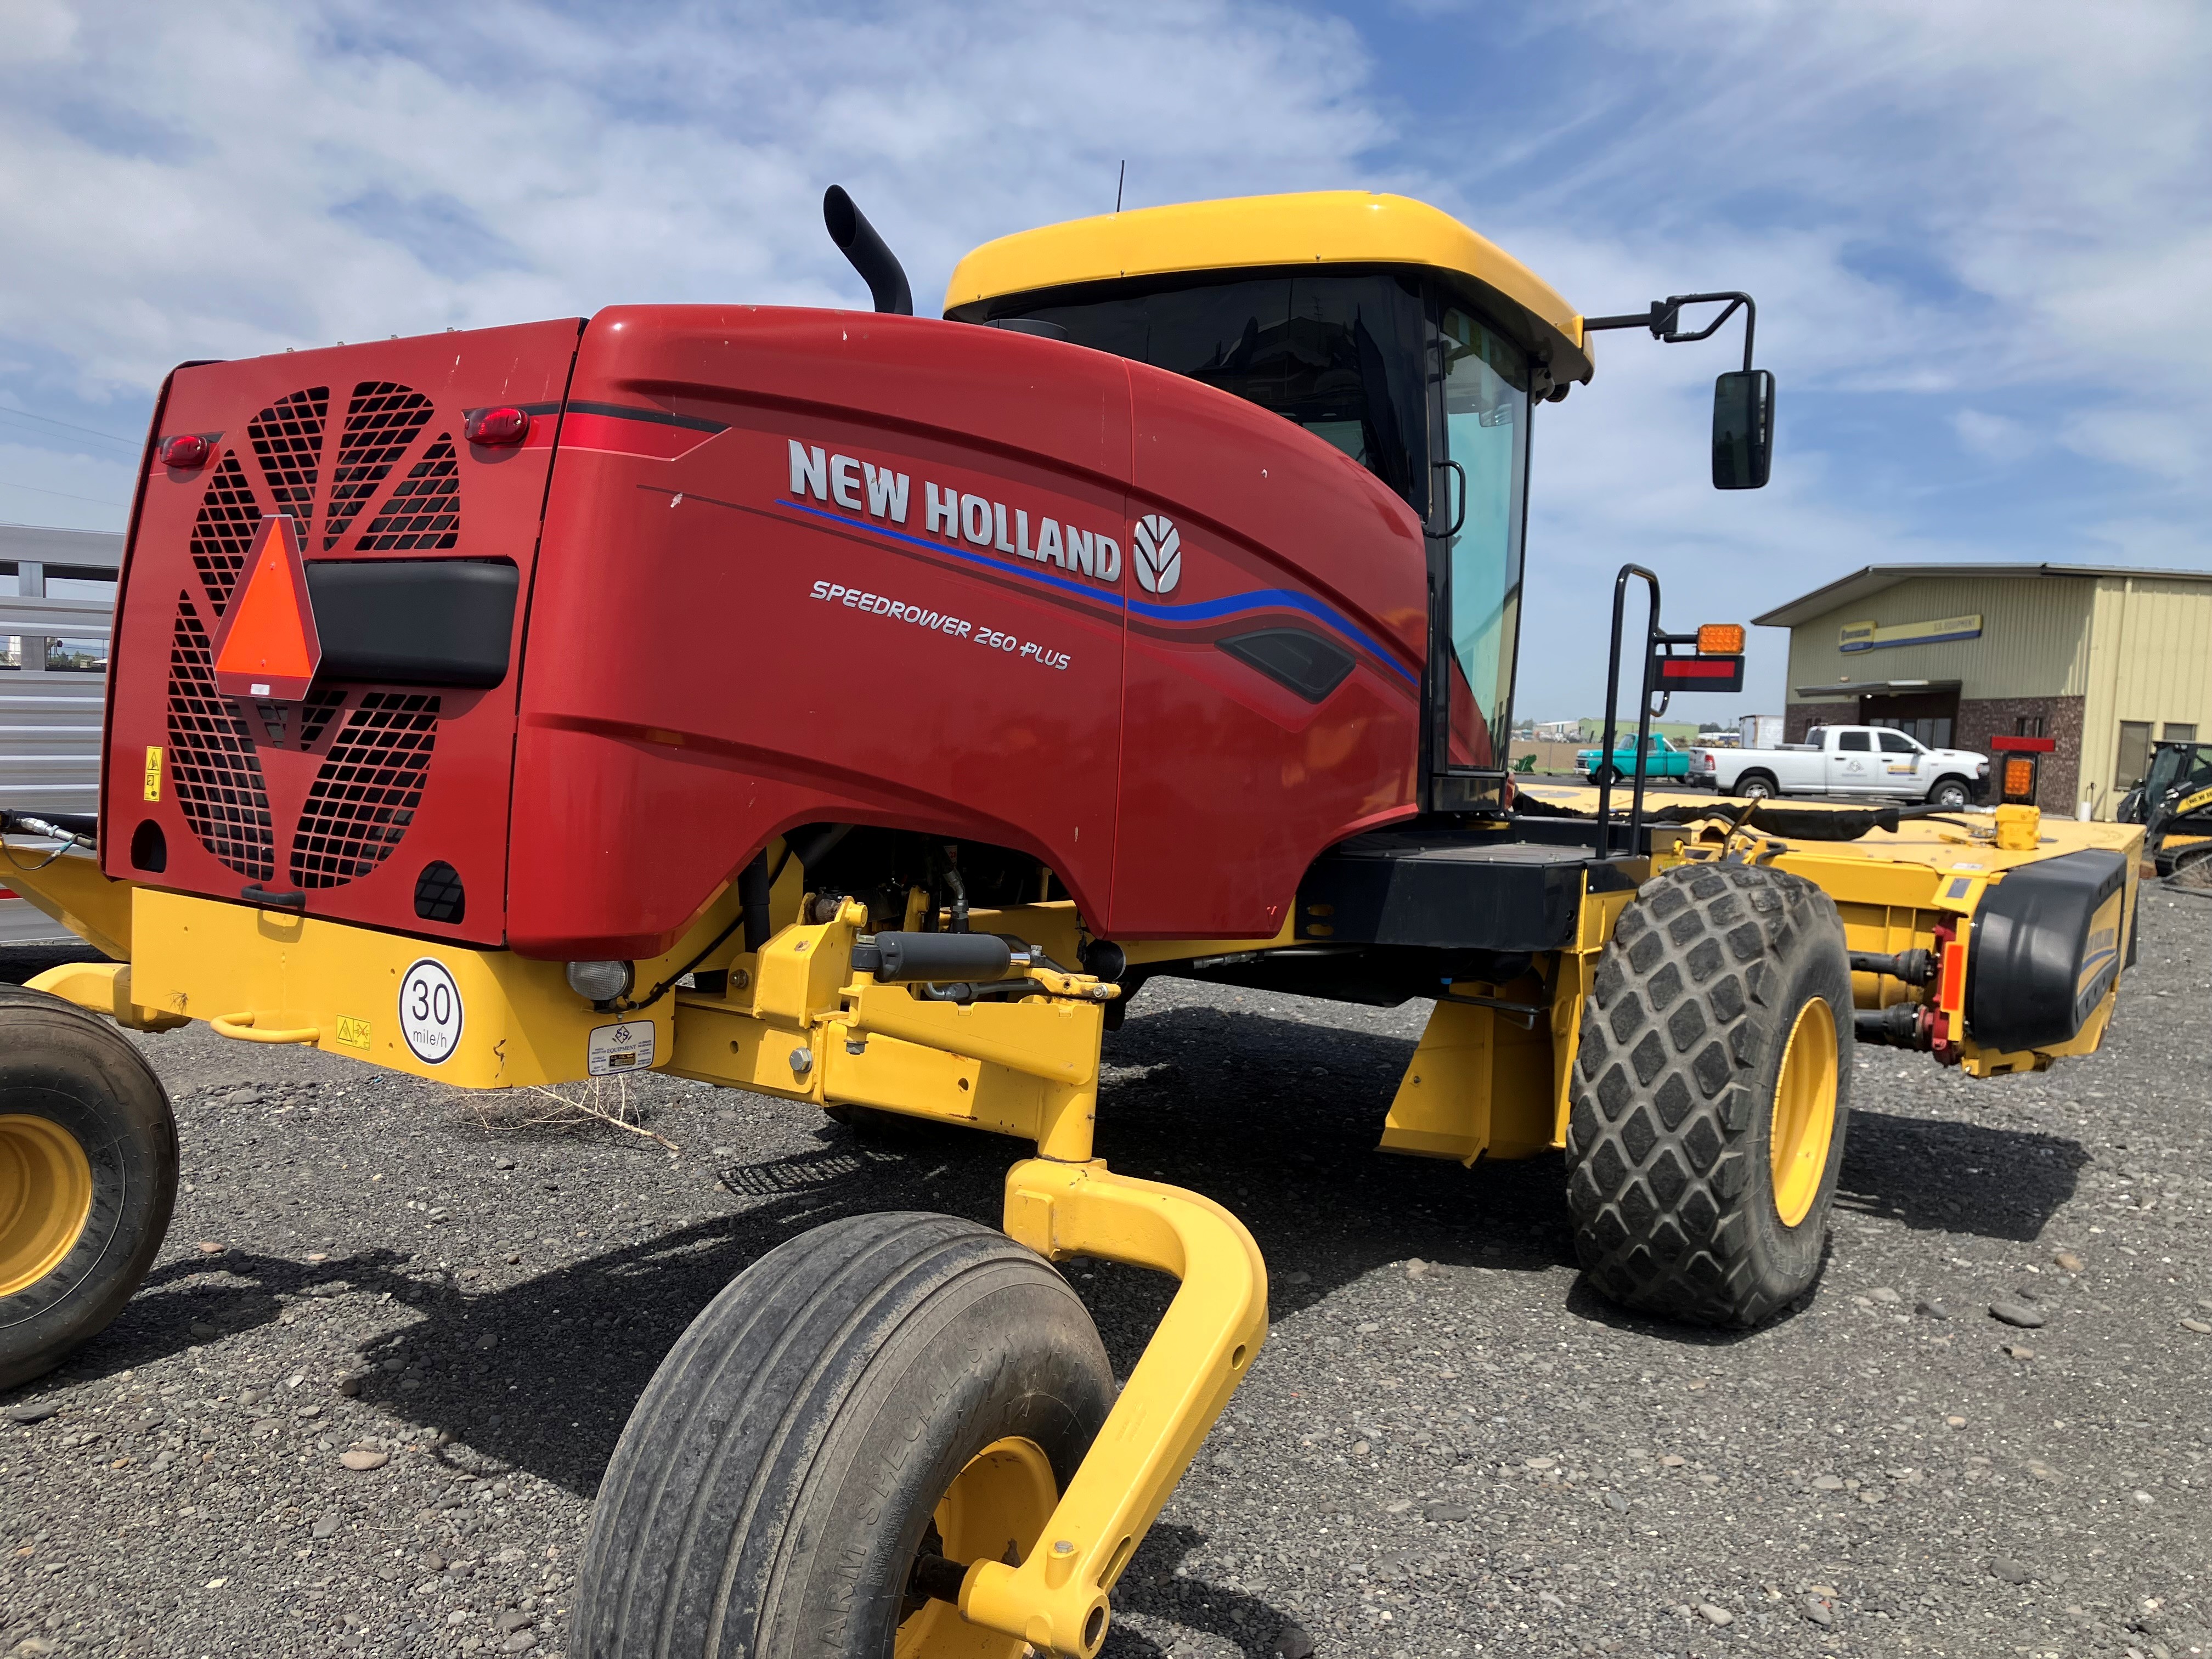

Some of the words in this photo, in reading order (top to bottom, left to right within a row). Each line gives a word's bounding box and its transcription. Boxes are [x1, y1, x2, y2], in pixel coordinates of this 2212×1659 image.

[788, 439, 910, 524] NEW
[925, 481, 1121, 582] HOLLAND
[809, 580, 972, 639] SPEEDROWER
[973, 626, 1017, 652] 260
[412, 979, 451, 1025] 30
[413, 1029, 447, 1048] mile/h
[607, 1044, 636, 1054] EQUIPMENT
[814, 1541, 867, 1659] ARM
